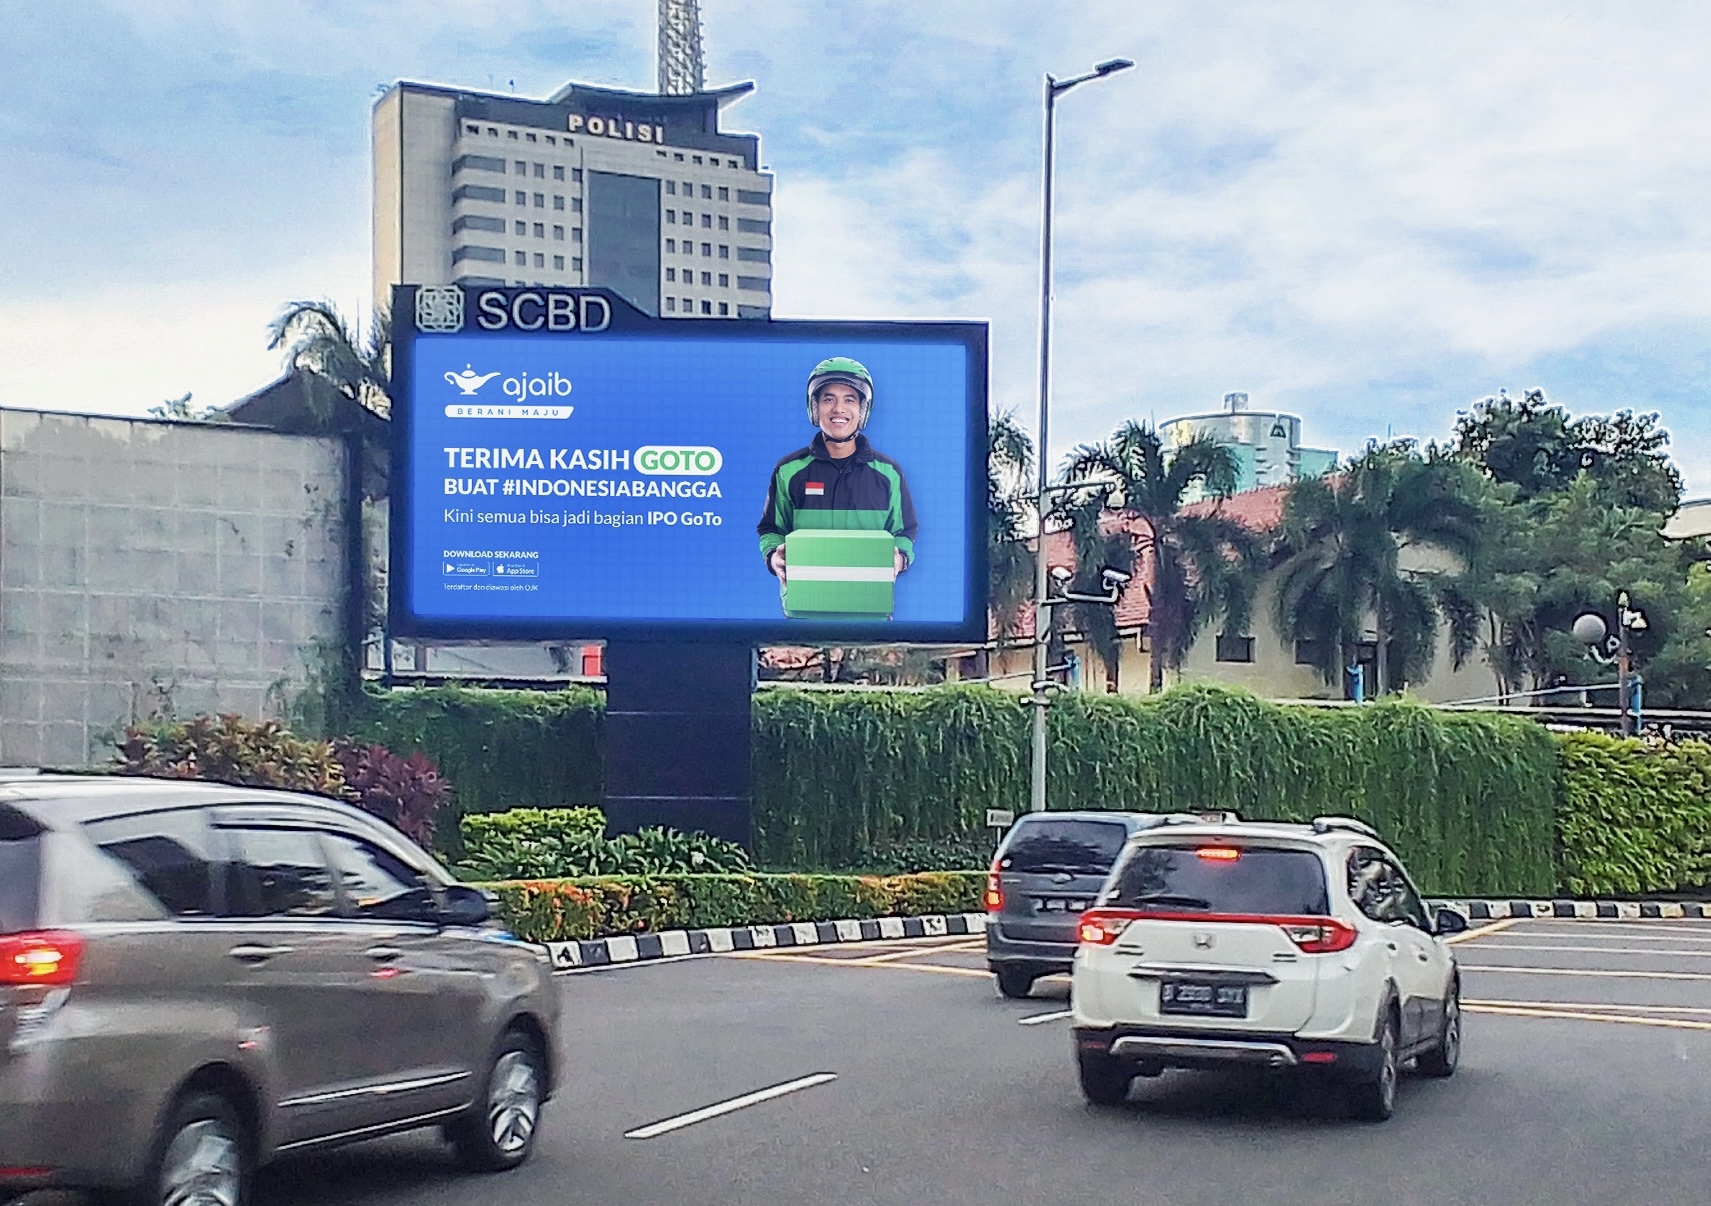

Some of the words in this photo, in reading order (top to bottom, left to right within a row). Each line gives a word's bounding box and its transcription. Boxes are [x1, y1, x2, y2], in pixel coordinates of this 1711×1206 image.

[568, 113, 664, 144] POLISI
[477, 292, 611, 332] SCBD
[503, 371, 573, 402] ajaib
[457, 407, 511, 417] BERANI
[521, 408, 560, 417] MAJU
[443, 447, 545, 469] TERIMA
[550, 449, 630, 470] KASIH
[640, 450, 716, 471] GOTO
[444, 478, 499, 495] BUAT
[502, 479, 723, 498] #INDONESIABANGGA
[444, 508, 474, 523] Kini
[477, 512, 526, 524] semua
[530, 510, 560, 525] bisa
[562, 510, 590, 527] jadi
[594, 511, 644, 528] bagian
[647, 511, 678, 525] IPO
[680, 512, 722, 526] GoTo
[443, 550, 493, 558] DOWNLOAD
[494, 550, 539, 559] SEKARANG
